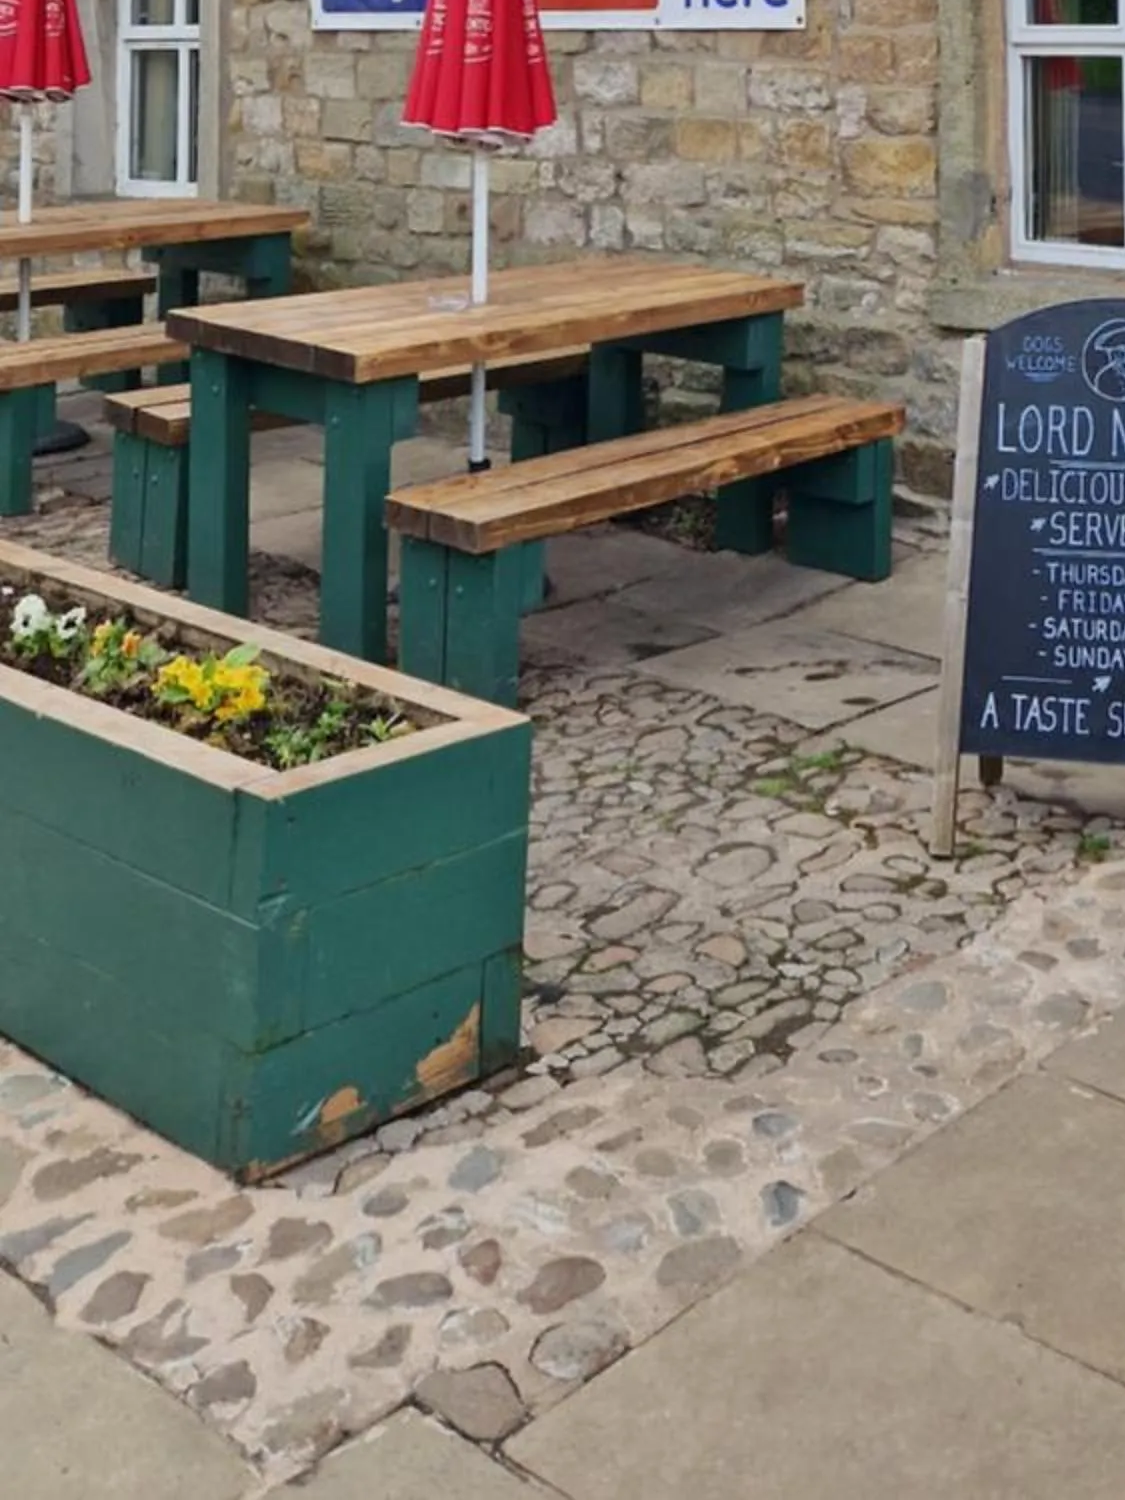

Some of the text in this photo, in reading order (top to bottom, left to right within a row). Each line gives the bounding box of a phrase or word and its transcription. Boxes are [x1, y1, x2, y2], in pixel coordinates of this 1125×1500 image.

[997, 403, 1095, 455] LORD
[980, 692, 1000, 729] A
[1011, 693, 1091, 735] TASTE
